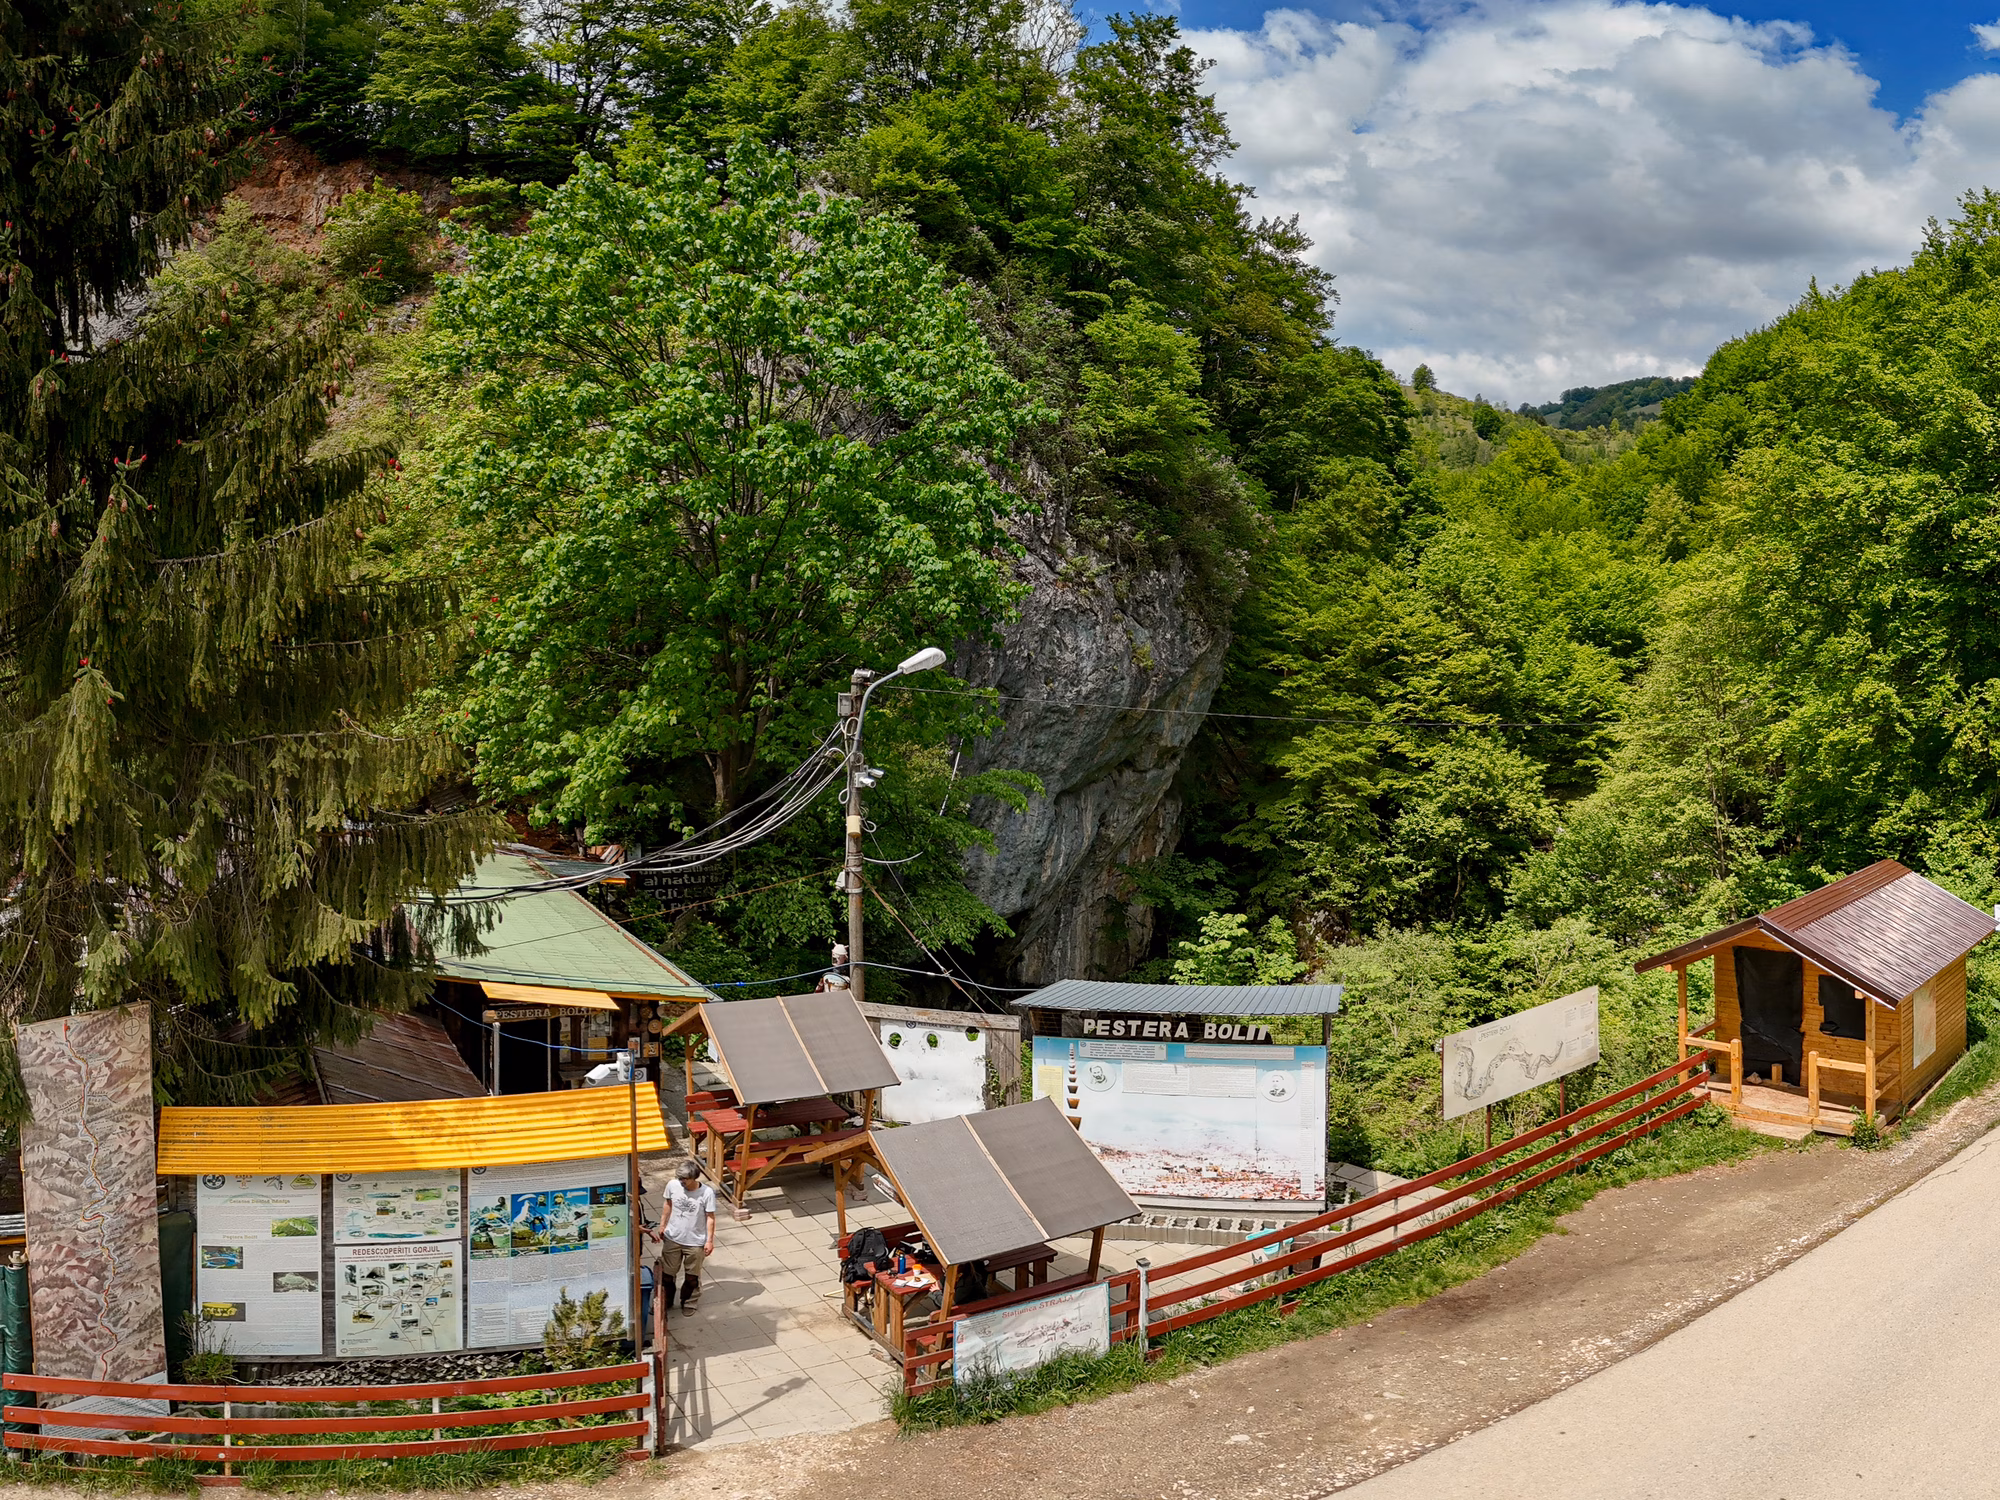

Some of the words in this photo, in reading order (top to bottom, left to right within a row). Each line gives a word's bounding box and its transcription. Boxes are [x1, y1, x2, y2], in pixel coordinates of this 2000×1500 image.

[495, 1008, 551, 1020] PESTERA
[1083, 1018, 1189, 1039] PESTERA
[412, 1245, 440, 1253] GORJUL
[1038, 1295, 1075, 1310] STRAJA
